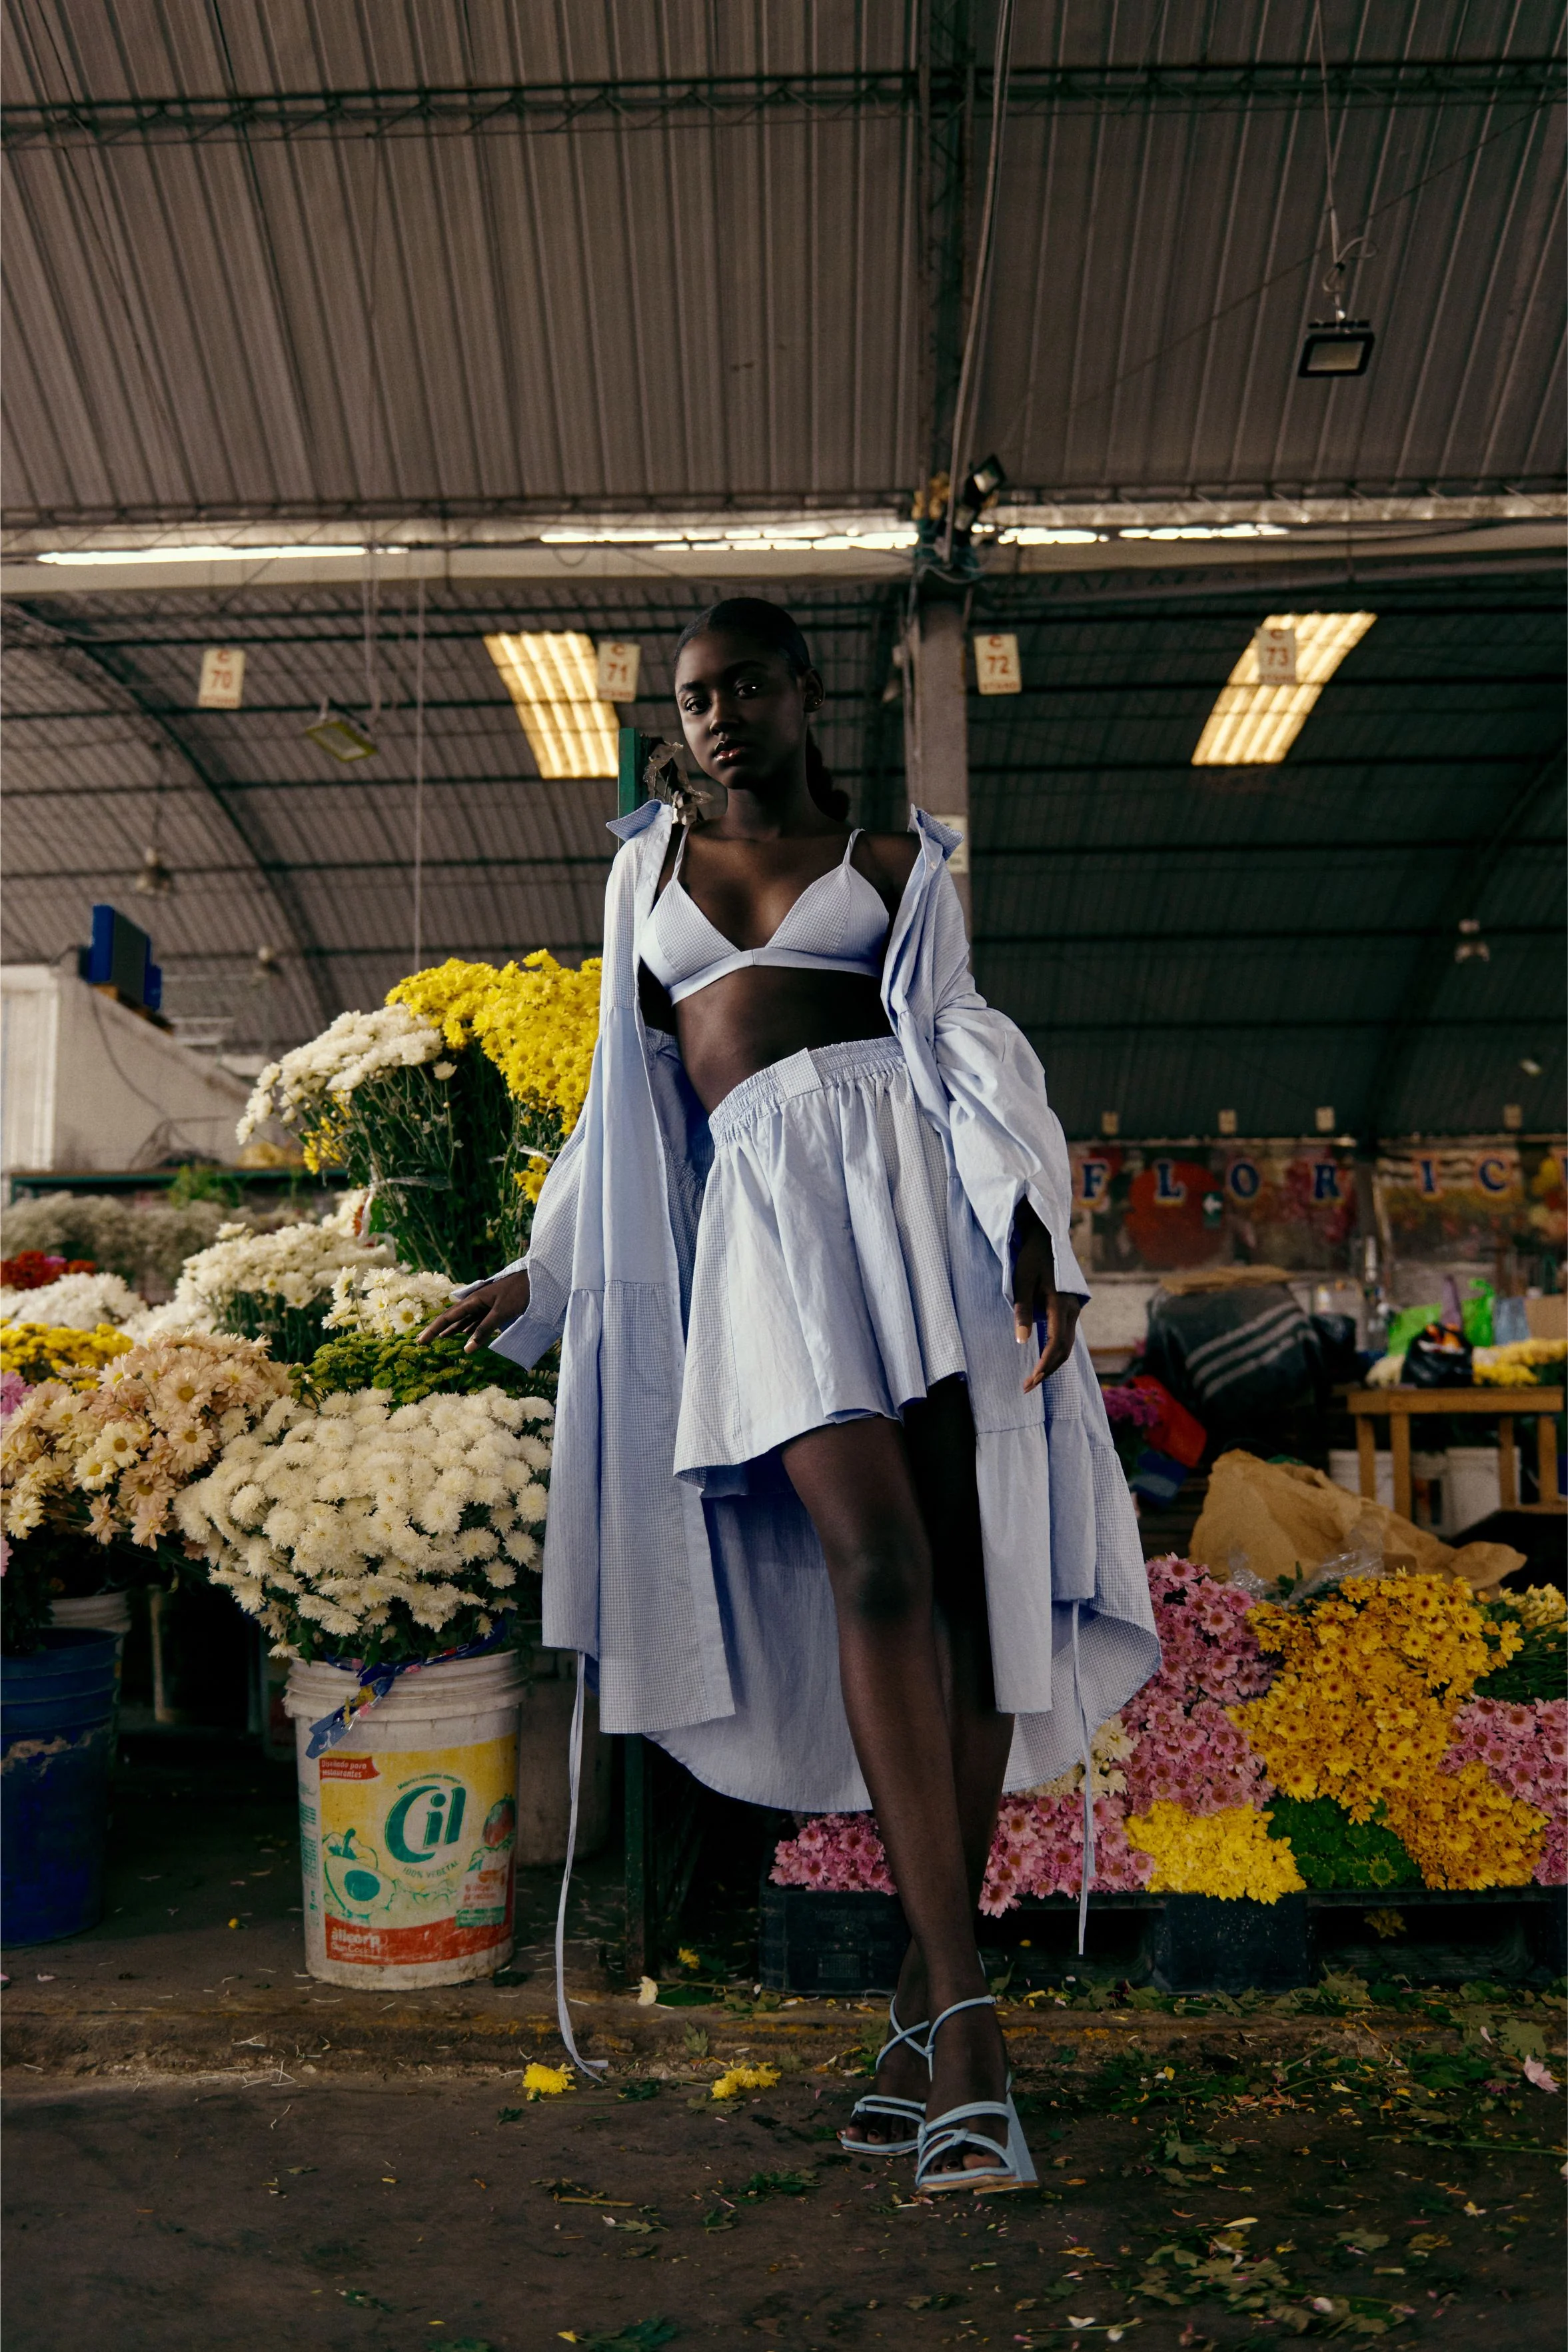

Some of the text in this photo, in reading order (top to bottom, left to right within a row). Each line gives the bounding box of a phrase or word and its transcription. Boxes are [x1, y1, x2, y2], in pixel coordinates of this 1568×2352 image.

[987, 656, 1009, 674] 72
[1267, 646, 1288, 666] 73
[212, 670, 232, 689] 70
[608, 662, 626, 682] 71
[1081, 1157, 1568, 1200] FLORIC
[350, 1762, 367, 1771] para
[386, 1785, 466, 1863] Cil
[402, 1860, 459, 1879] 100% VEGETAL
